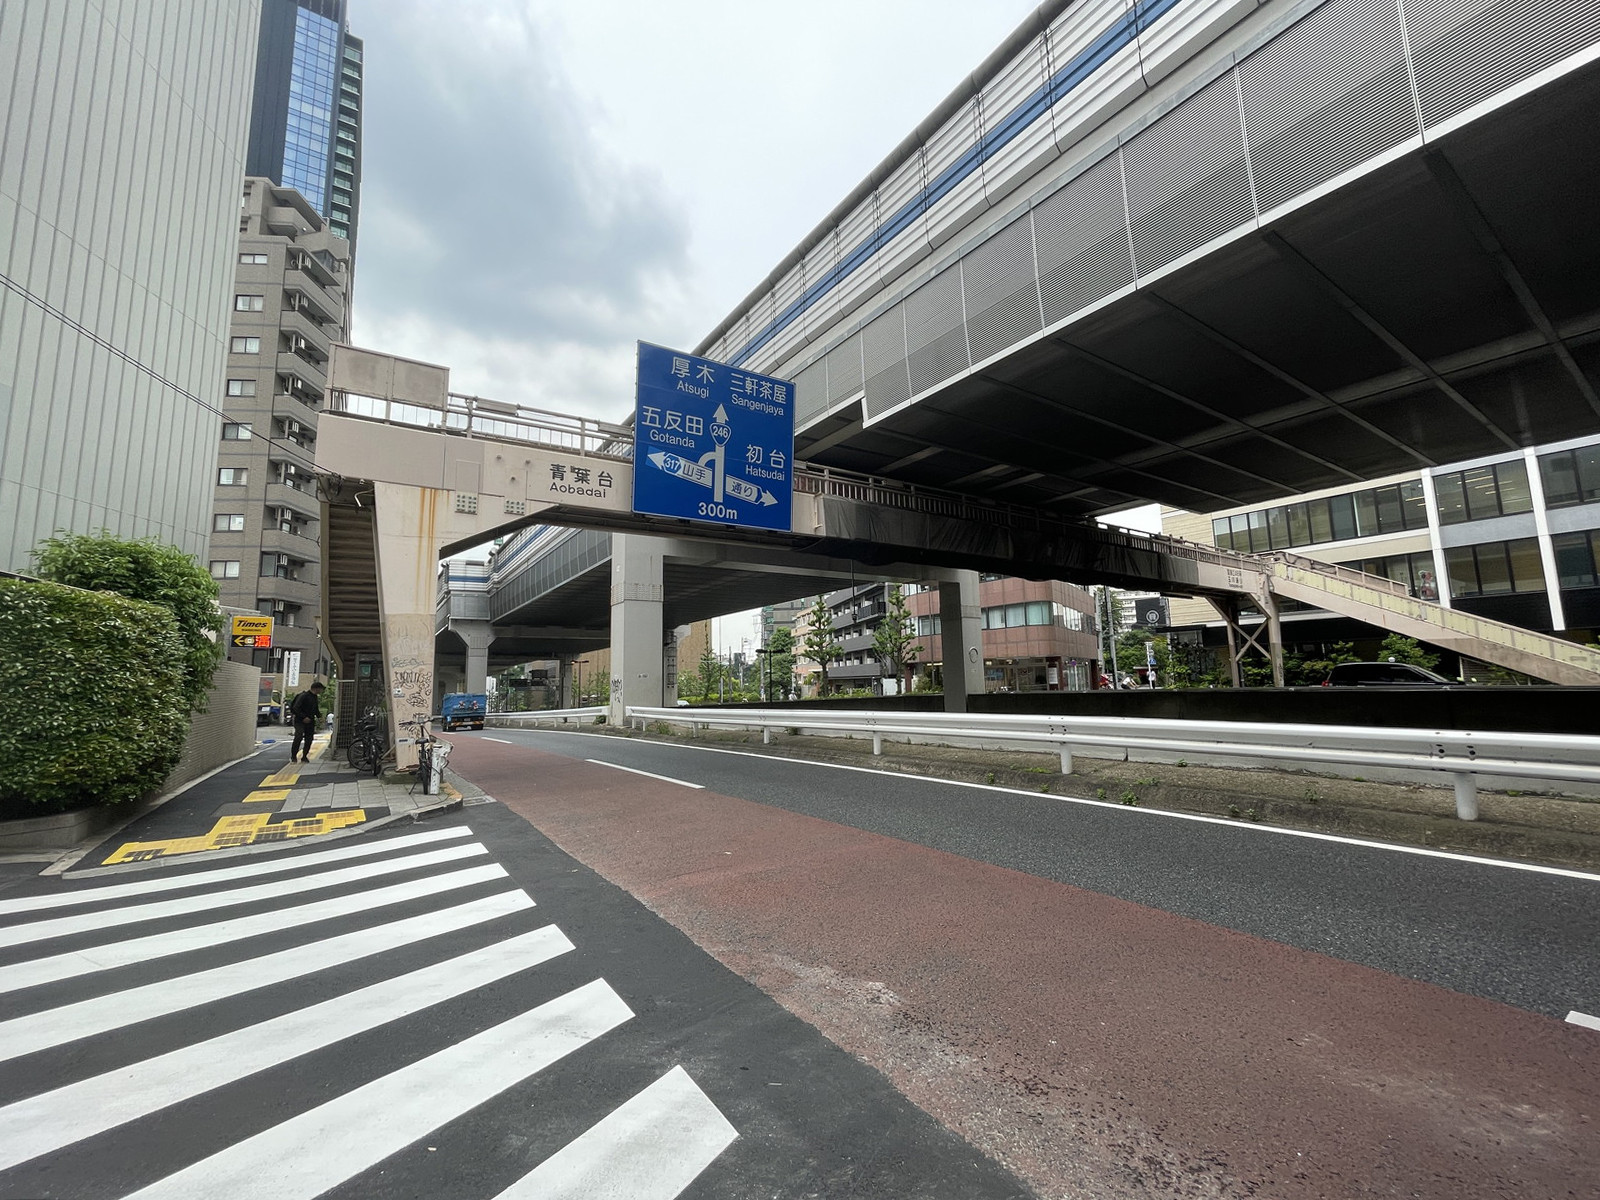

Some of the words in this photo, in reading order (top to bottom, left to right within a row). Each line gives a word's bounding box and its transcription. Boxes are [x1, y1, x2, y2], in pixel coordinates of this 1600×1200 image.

[671, 356, 715, 384] 厚木
[676, 380, 710, 399] Atsugi
[729, 372, 787, 405] 三軒茶屋
[731, 393, 785, 416] Sangenjaya
[641, 405, 704, 436] 五反田
[650, 429, 695, 448] Gotanda
[712, 425, 729, 438] 246
[664, 457, 680, 470] 317
[745, 444, 786, 469] 初台
[550, 464, 613, 488] 青葉台
[683, 463, 707, 481] 山手
[731, 481, 753, 498] 通り
[745, 466, 785, 481] Hatsudai
[549, 482, 606, 498] Aobadai
[698, 502, 738, 520] 300m
[237, 620, 268, 628] Times
